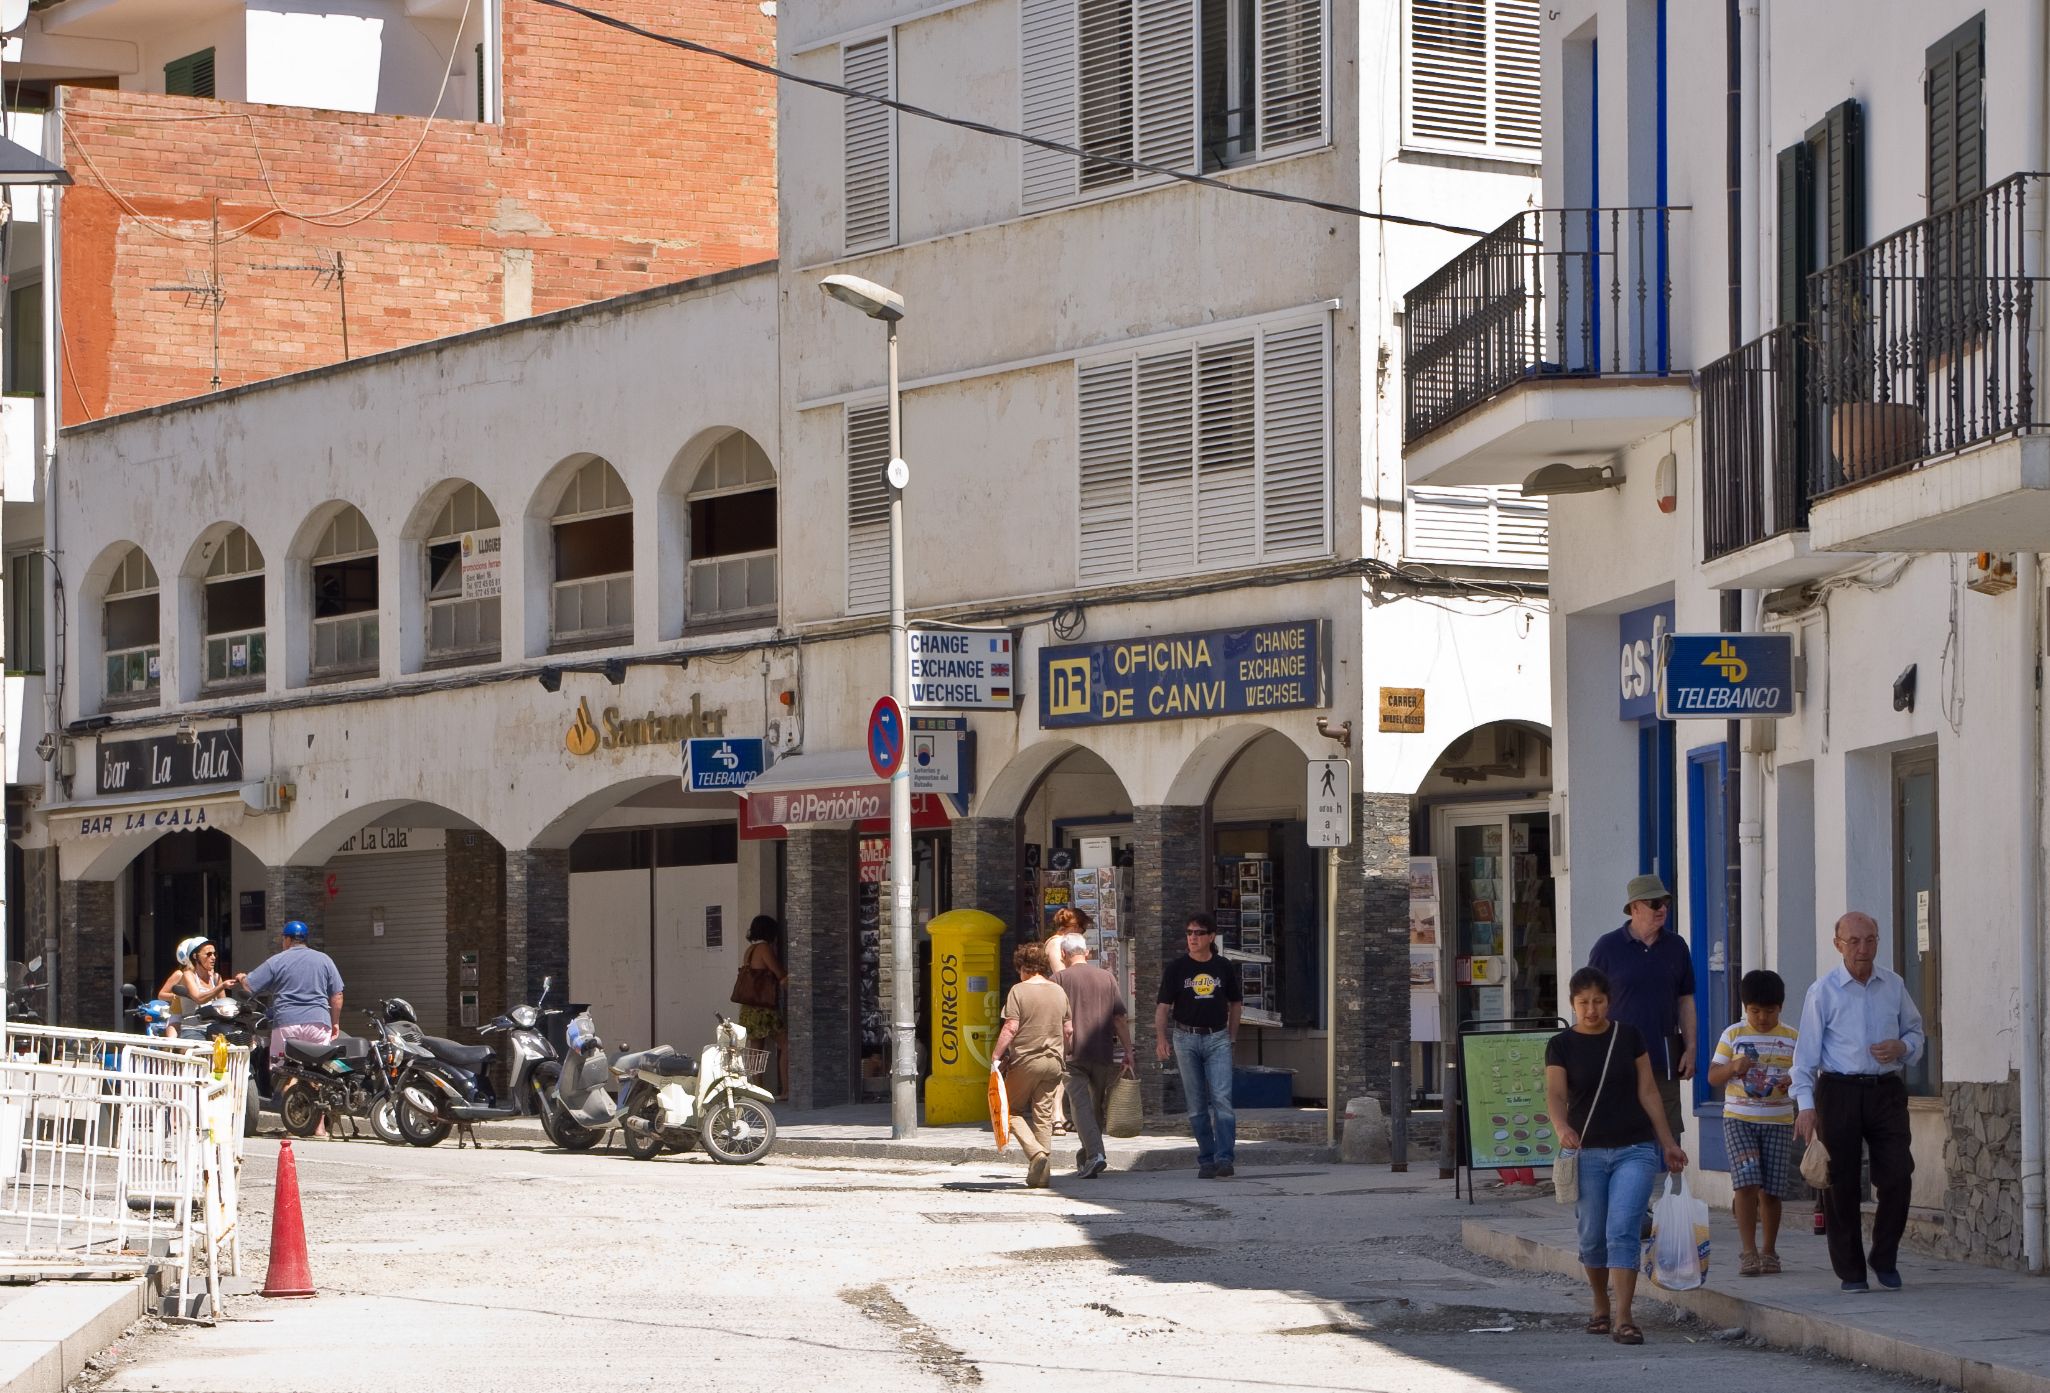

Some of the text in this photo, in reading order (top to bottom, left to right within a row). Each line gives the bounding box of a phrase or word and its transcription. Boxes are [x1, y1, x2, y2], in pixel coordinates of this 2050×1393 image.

[911, 634, 969, 654] CHANGE
[1255, 628, 1305, 654] CHANGE
[911, 659, 984, 678] EXCHANGE
[1114, 639, 1212, 676] OFICINA
[1239, 655, 1306, 681] EXCHANGE
[912, 683, 982, 703] WECHSEL
[1102, 681, 1226, 718] DE CANVI
[1245, 682, 1305, 707] WECHSEL
[1388, 695, 1417, 708] CARRER
[1677, 687, 1780, 709] TELEBANCO
[602, 692, 727, 750] Santander
[103, 751, 130, 789] bar
[152, 745, 172, 785] La
[698, 771, 757, 786] TELEBANCO
[789, 791, 880, 823] el Periódico
[1336, 803, 1342, 814] h
[81, 807, 207, 835] BAR LA CALA
[1324, 820, 1331, 829] a
[361, 828, 377, 850] La
[1334, 832, 1340, 844] h
[940, 953, 959, 1065] CORREOS
